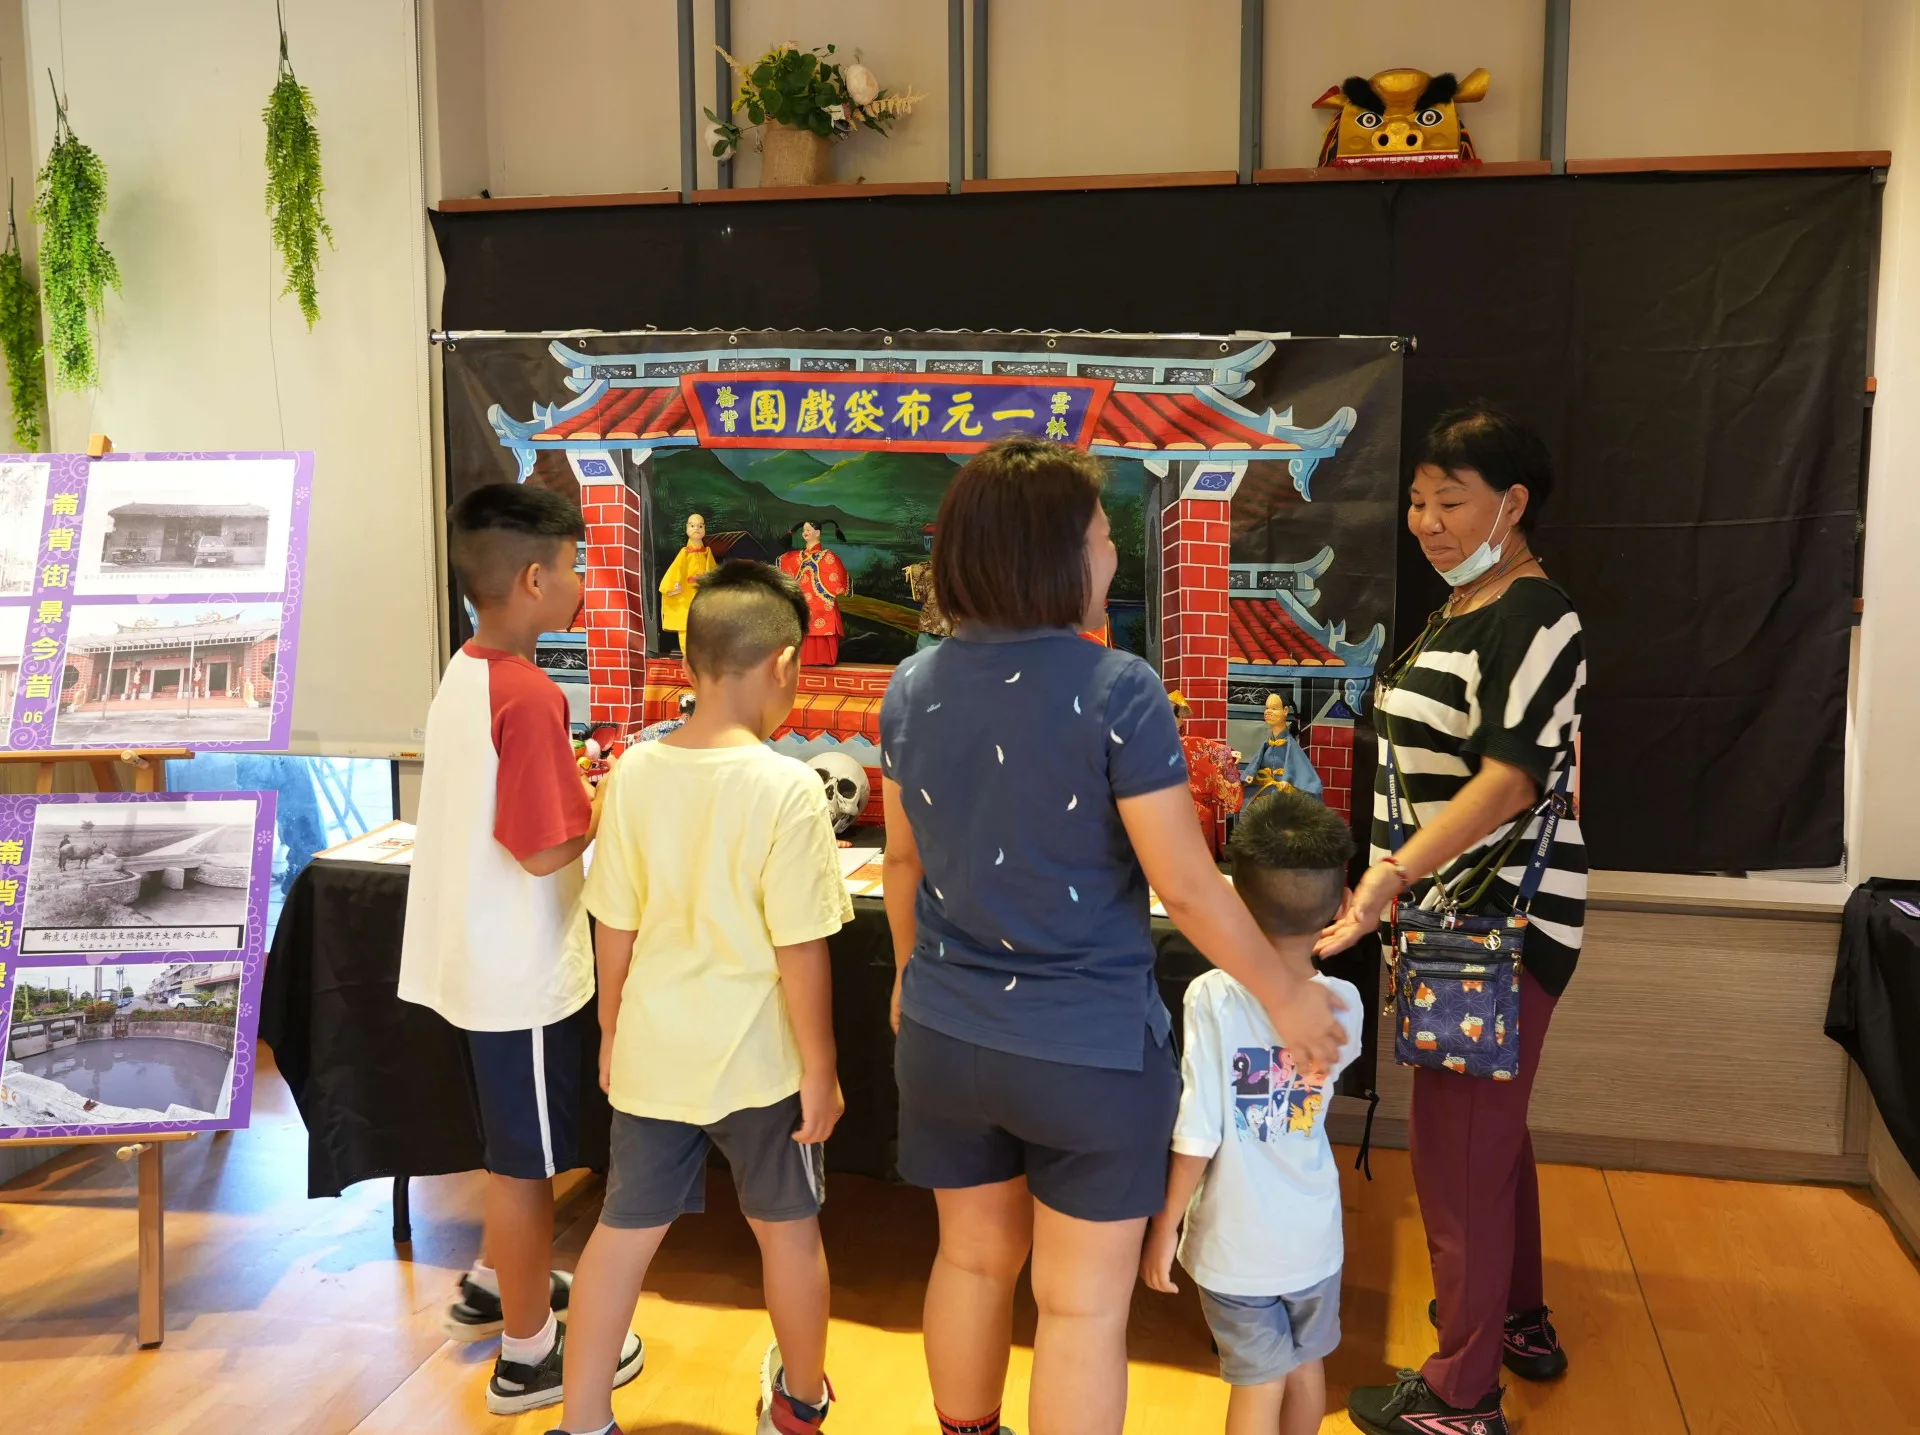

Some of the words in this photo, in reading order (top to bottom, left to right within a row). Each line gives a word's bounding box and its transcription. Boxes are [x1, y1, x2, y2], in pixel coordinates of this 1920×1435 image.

[1045, 391, 1072, 441] 雲林
[25, 492, 80, 699] 崙背街景今昔
[23, 711, 43, 724] 06
[1388, 774, 1399, 819] BEDDYBEAR
